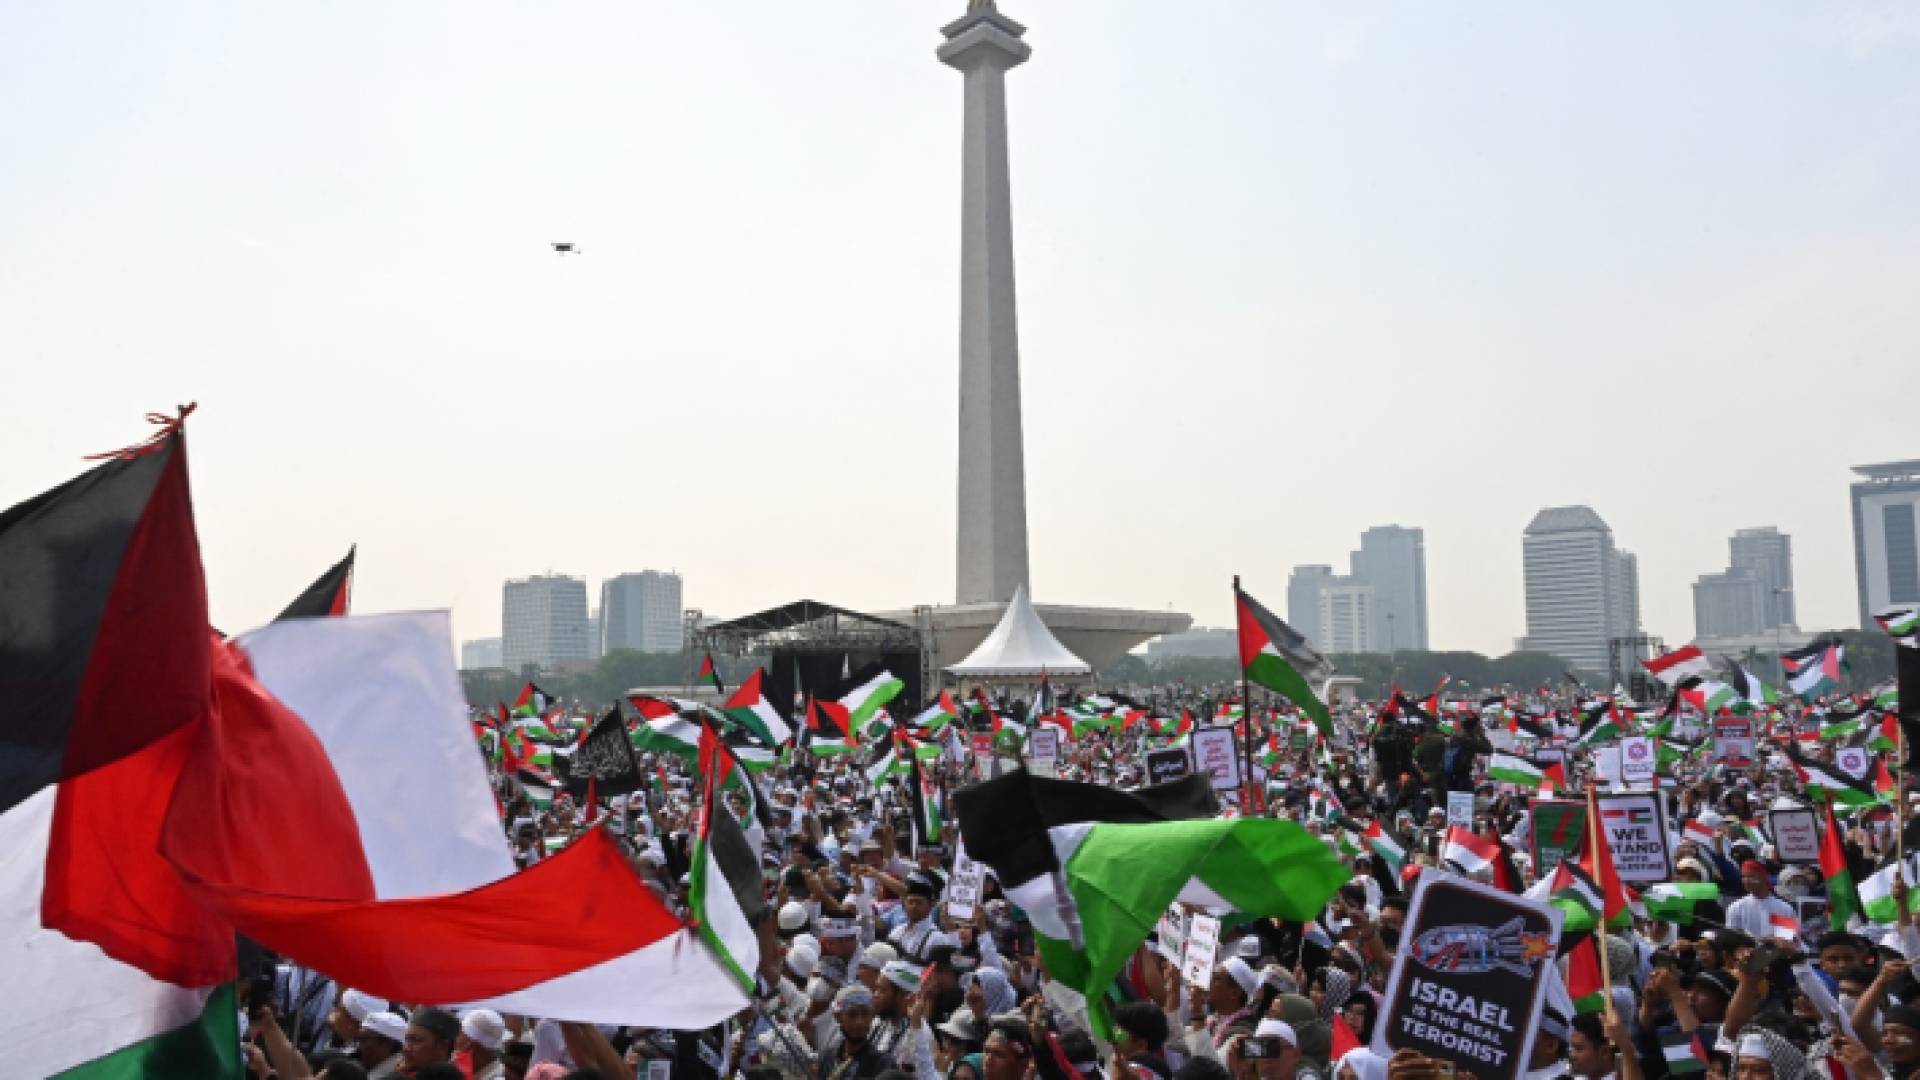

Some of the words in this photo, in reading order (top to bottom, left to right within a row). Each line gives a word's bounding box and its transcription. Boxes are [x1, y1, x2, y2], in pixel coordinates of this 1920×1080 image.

[1612, 827, 1648, 841] WE
[1410, 977, 1514, 1032] ISRAEL
[1412, 1003, 1427, 1017] IS
[1430, 1009, 1459, 1029] THE
[1463, 1022, 1502, 1046] REAL
[1401, 1015, 1508, 1066] TERORIST
